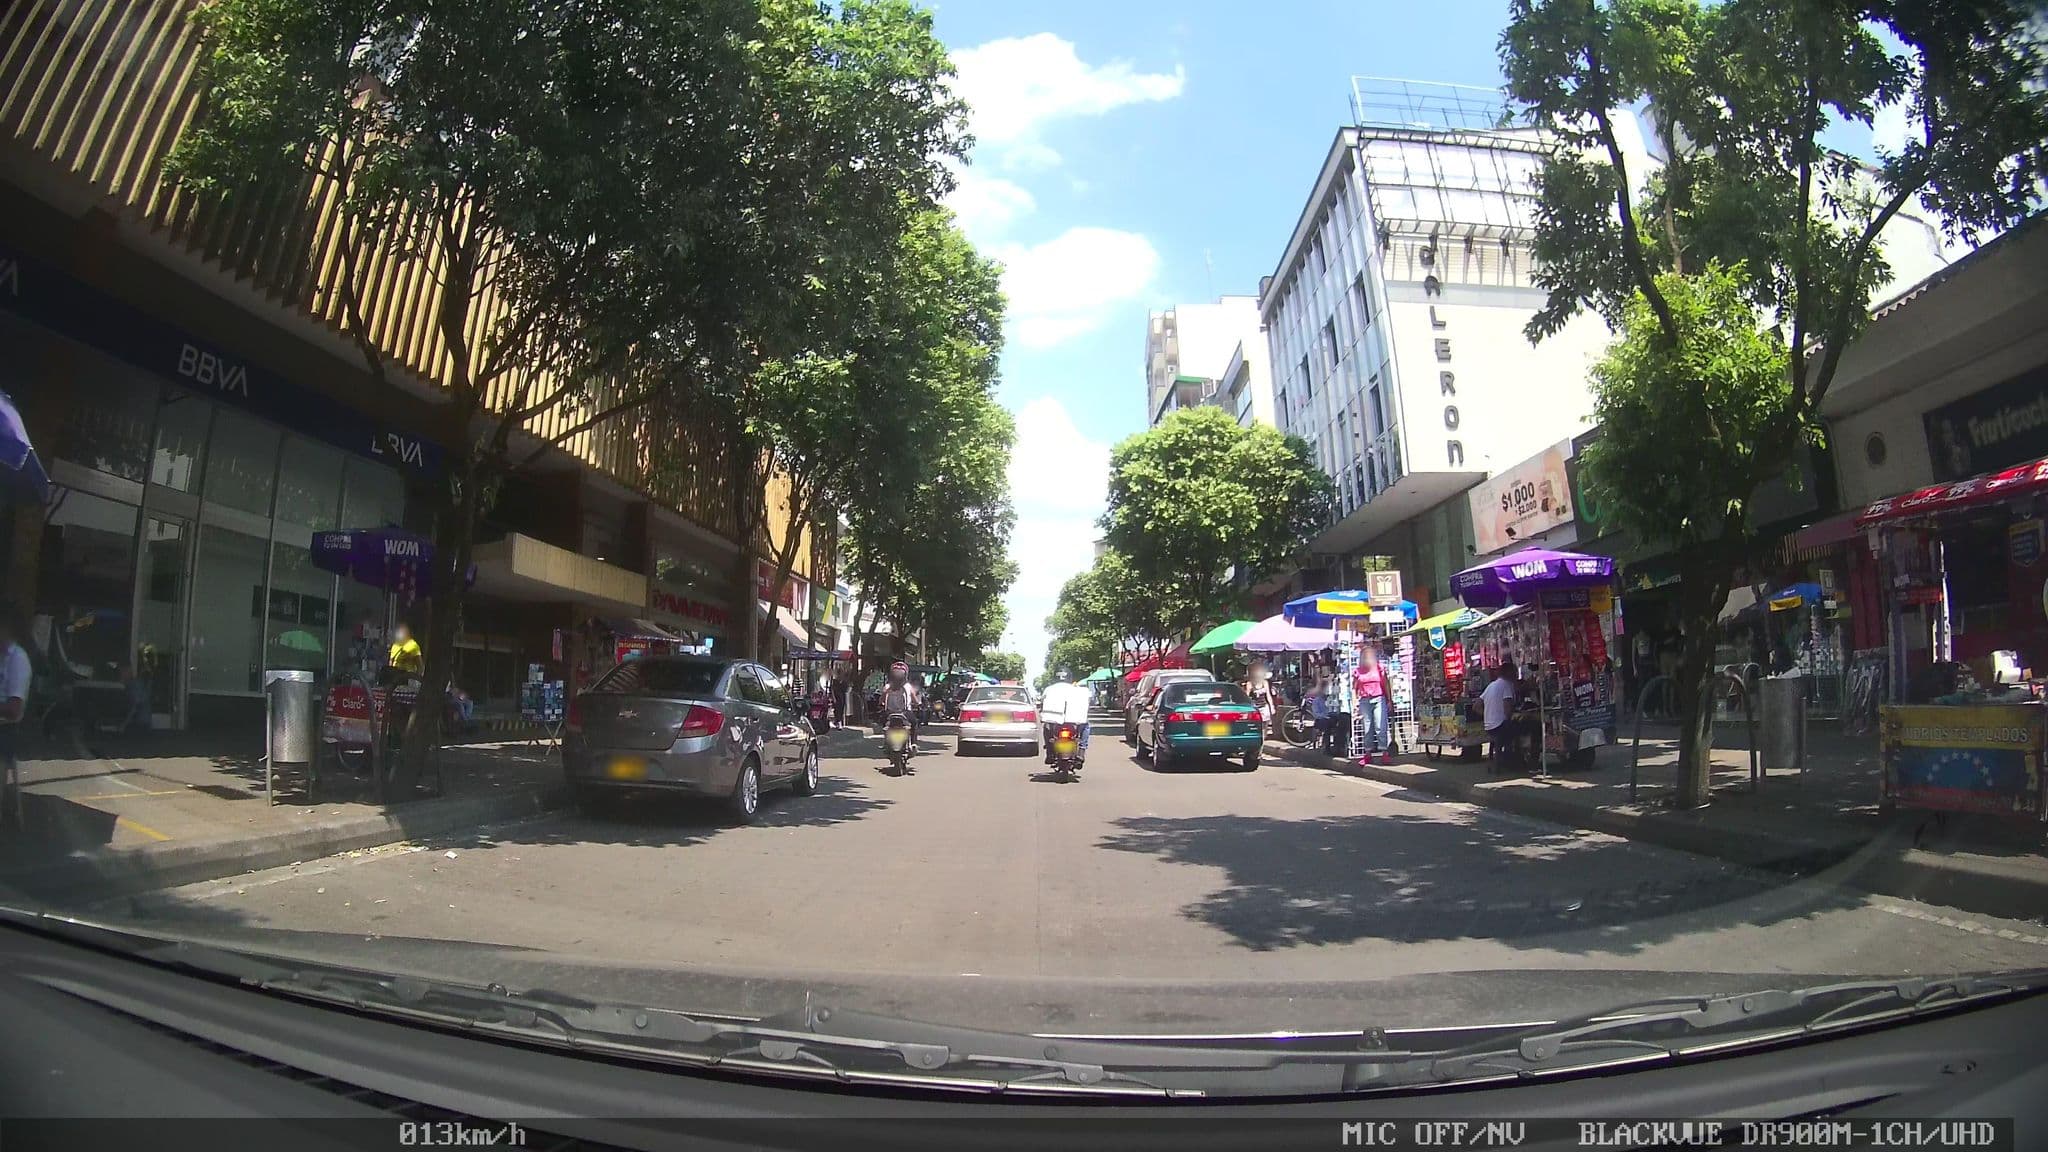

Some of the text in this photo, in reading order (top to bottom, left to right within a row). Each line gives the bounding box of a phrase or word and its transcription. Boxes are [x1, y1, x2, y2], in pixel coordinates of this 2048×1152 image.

[177, 343, 248, 396] BBVA
[1501, 481, 1535, 512] $1.000
[1901, 495, 1932, 508] Claro
[384, 539, 419, 557] WOM
[1511, 560, 1548, 579] WOM
[1574, 682, 1594, 697] WOM
[342, 696, 363, 709] Claro
